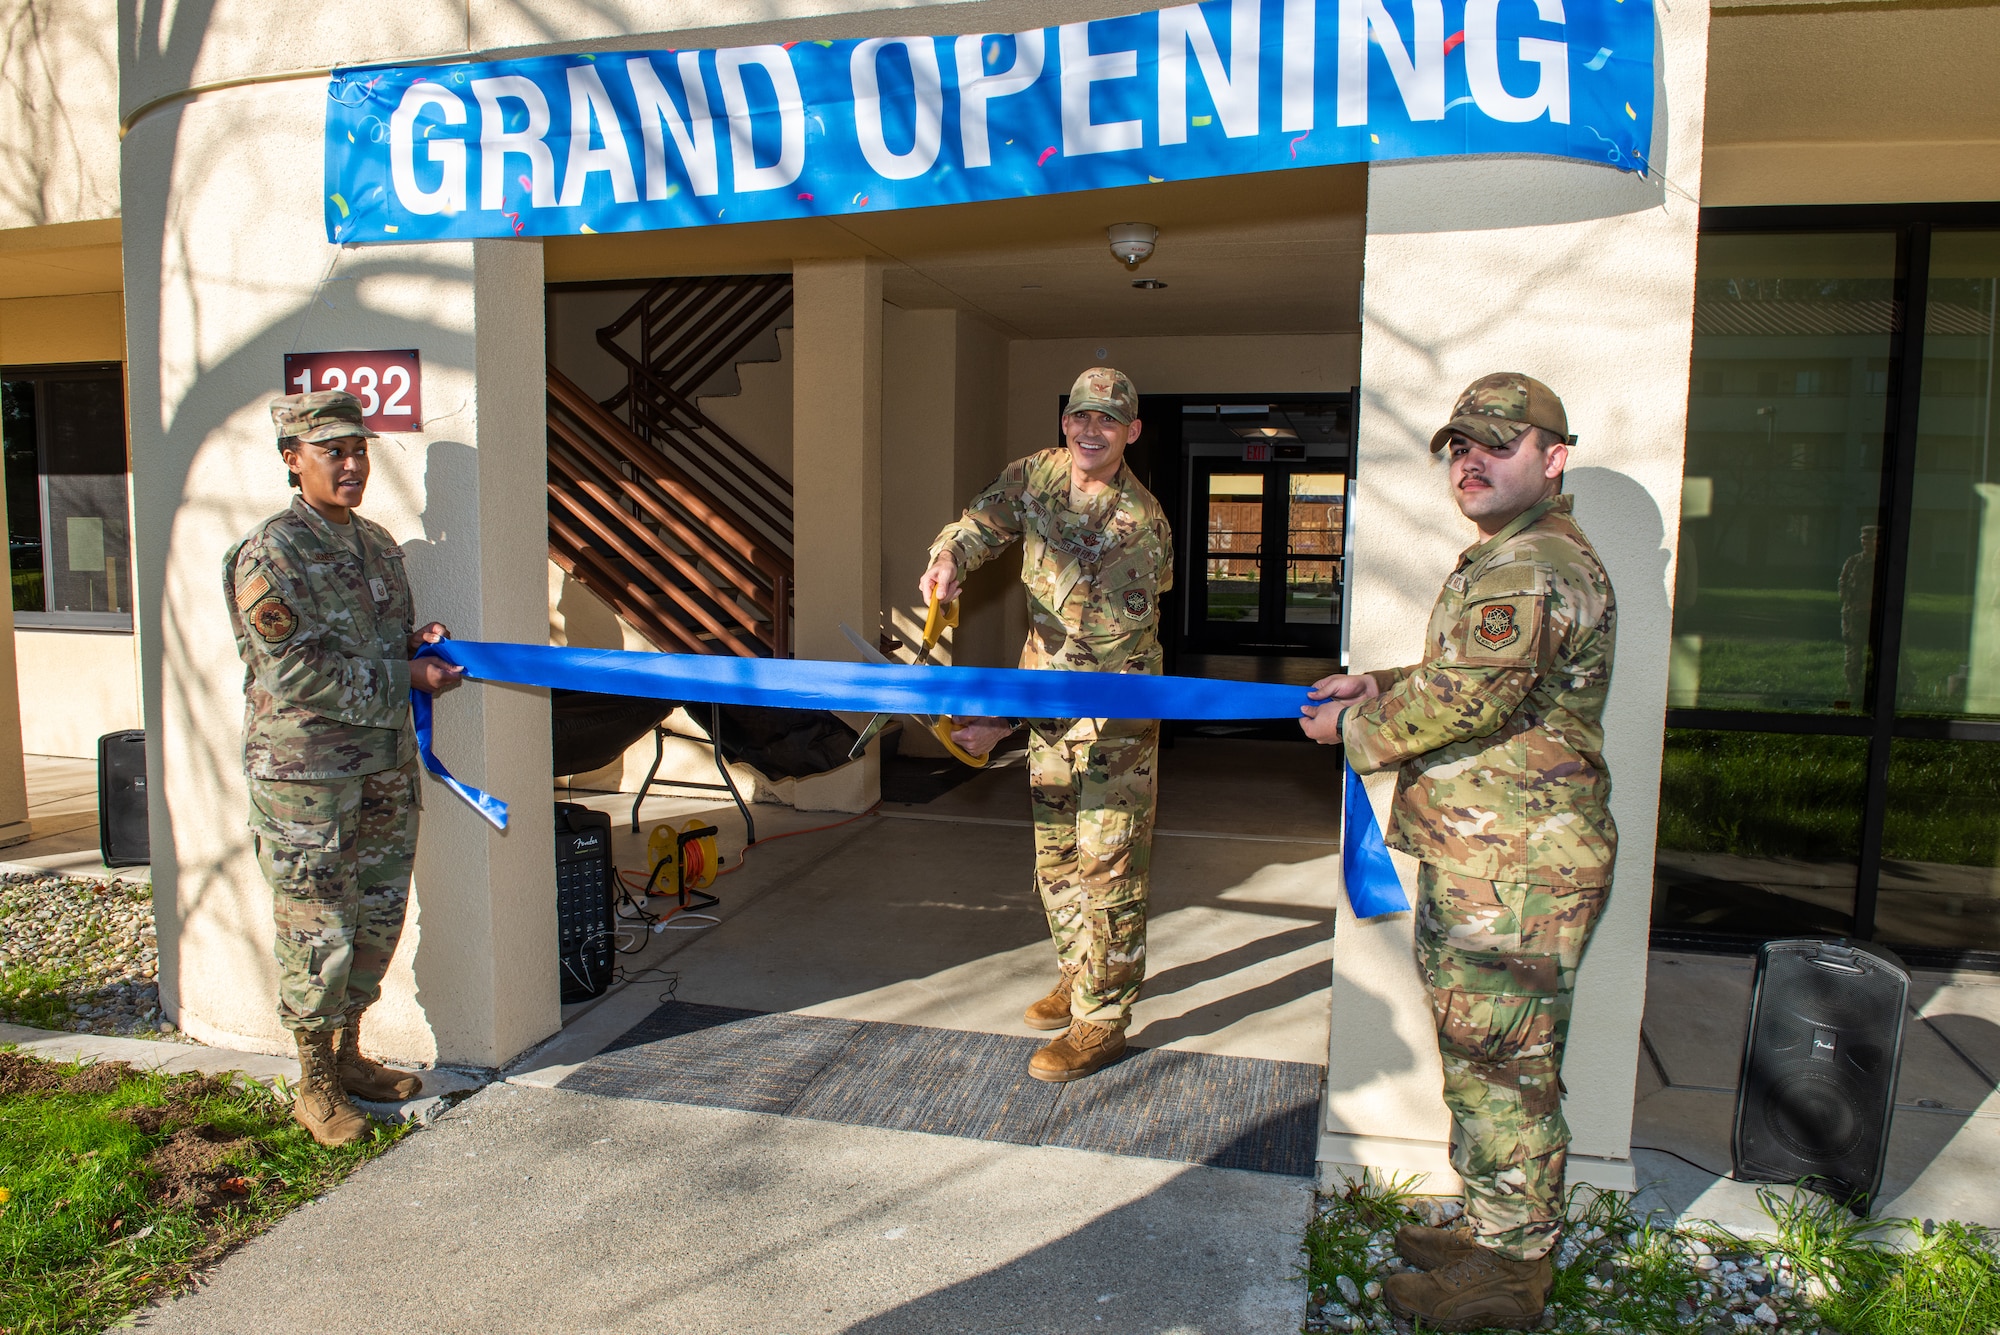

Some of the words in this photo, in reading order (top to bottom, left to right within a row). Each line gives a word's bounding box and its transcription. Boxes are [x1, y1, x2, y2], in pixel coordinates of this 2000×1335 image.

[390, 44, 806, 216] GRAND
[851, 0, 1571, 180] OPENING
[1247, 444, 1268, 461] EXIT
[315, 552, 337, 562] JONES
[573, 835, 598, 850] Fender
[1813, 1039, 1835, 1051] Fender
